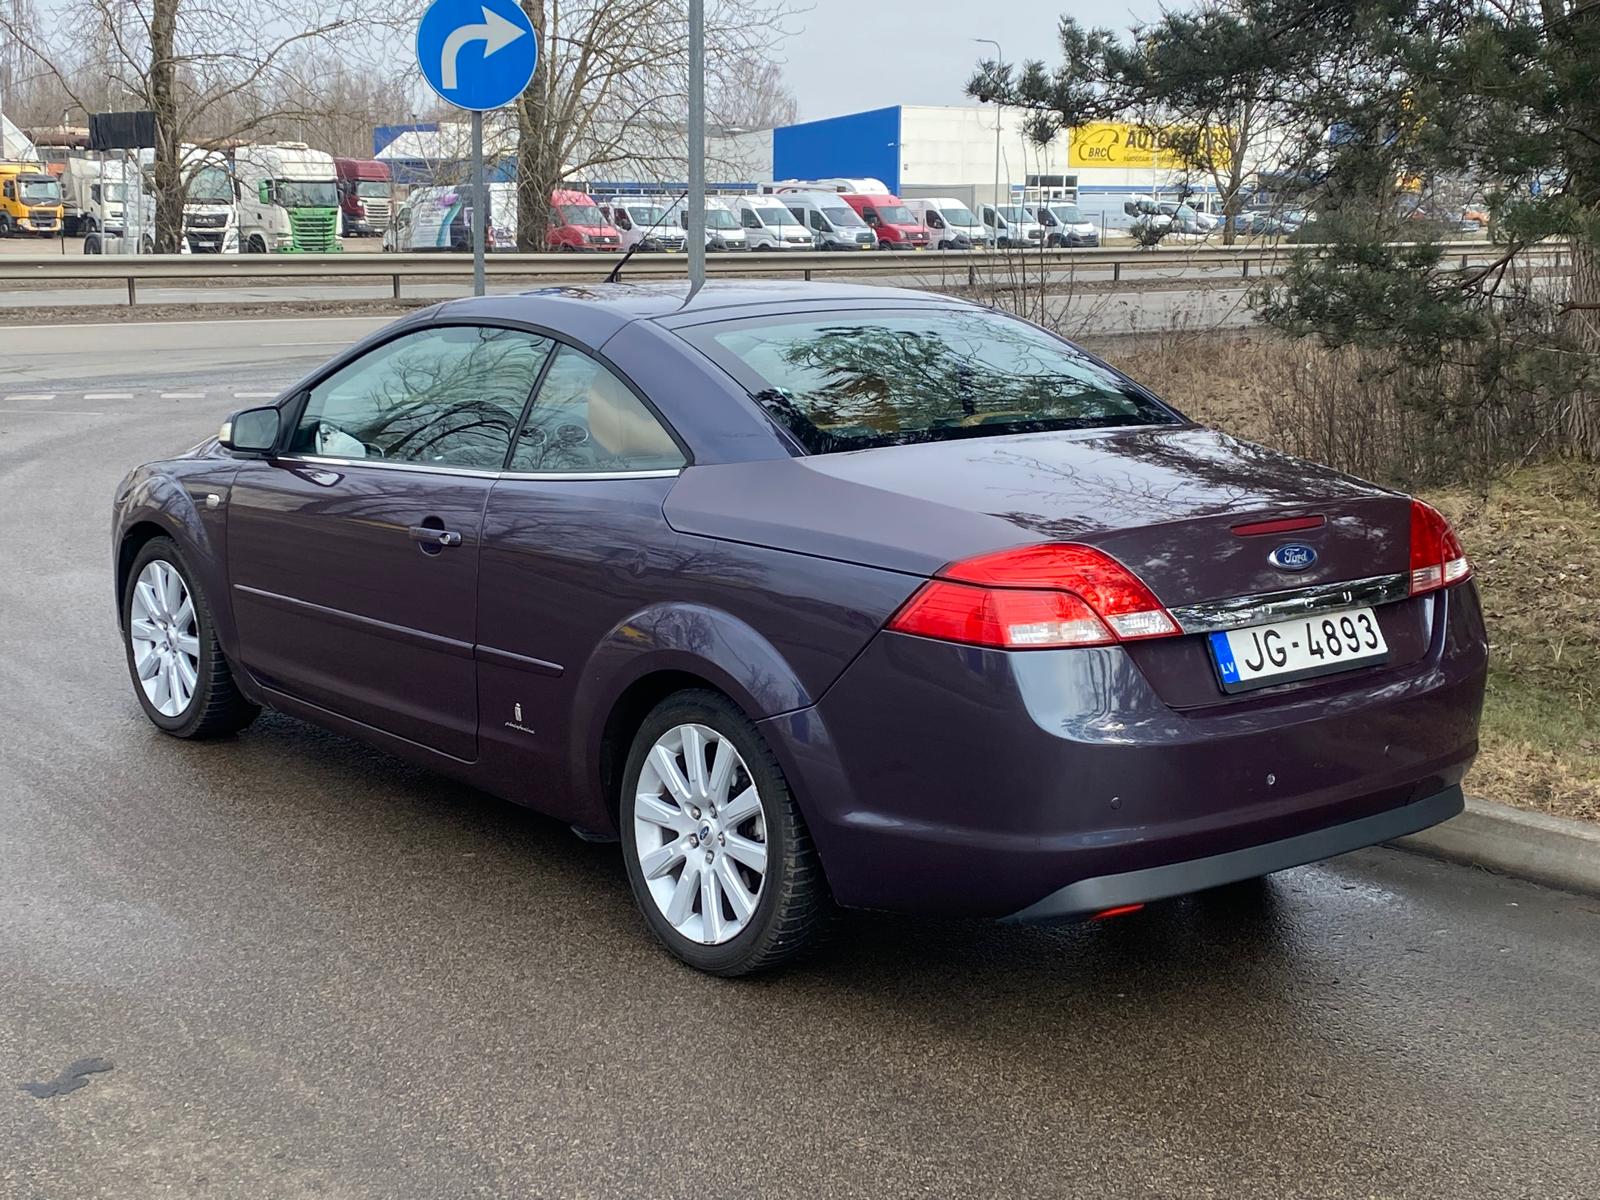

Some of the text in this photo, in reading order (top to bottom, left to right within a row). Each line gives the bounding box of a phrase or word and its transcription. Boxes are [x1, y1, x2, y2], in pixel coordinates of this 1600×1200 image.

[1088, 147, 1107, 157] BRC
[1284, 548, 1308, 564] Ford
[1244, 613, 1379, 672] JG-4893
[1221, 662, 1235, 675] LV
